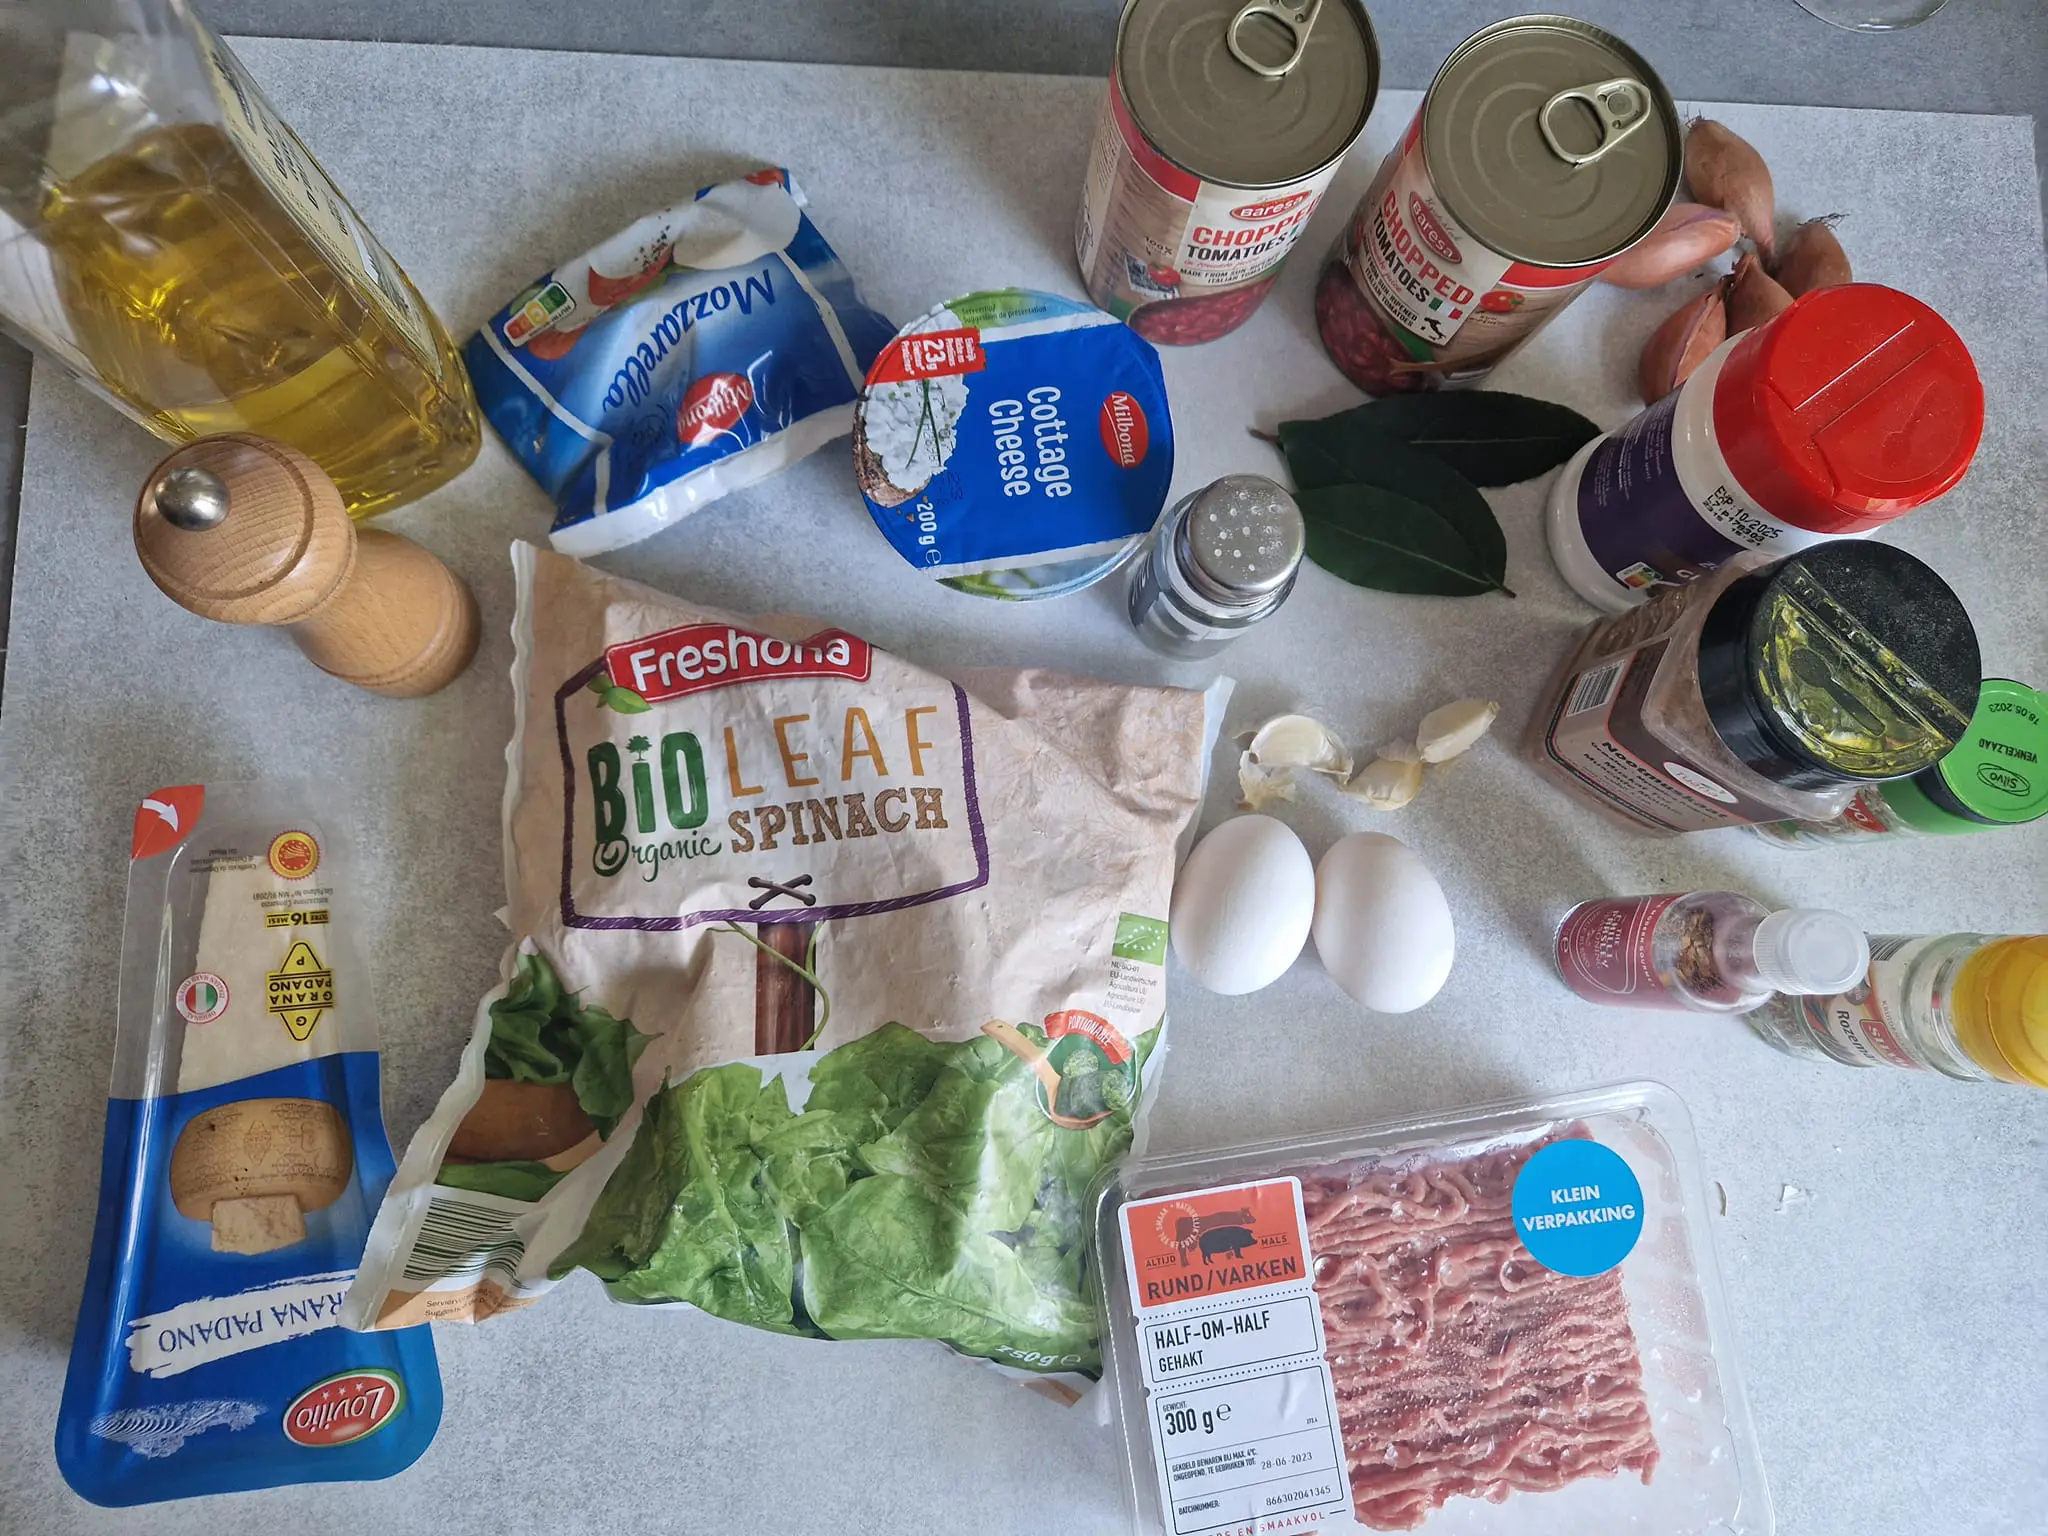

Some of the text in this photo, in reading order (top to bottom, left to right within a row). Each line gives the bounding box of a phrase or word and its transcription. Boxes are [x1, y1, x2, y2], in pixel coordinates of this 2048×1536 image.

[1240, 196, 1304, 217] Baresa
[1412, 200, 1453, 258] Baresa
[1187, 232, 1287, 262] TOMATOES
[1373, 207, 1430, 303] TOMATOES
[1384, 190, 1475, 305] CHOPPED
[1382, 296, 1413, 327] TOMATOES
[603, 269, 777, 414] Mozzarella
[1027, 385, 1073, 498] Cottage
[1110, 393, 1136, 465] Milbona
[989, 399, 1031, 497] Cheese
[916, 502, 937, 532] 200
[630, 628, 851, 693] Freshona
[723, 705, 938, 798] LEAF
[1979, 738, 2038, 764] VENKELZAAD
[1990, 772, 2019, 789] Silvo
[727, 787, 949, 853] SPINACH
[592, 829, 723, 882] Organic
[268, 917, 289, 925] MESI
[291, 912, 309, 926] 16
[296, 956, 305, 966] P
[269, 977, 332, 992] PADANO
[269, 991, 333, 1005] GRANA
[296, 1015, 307, 1027] G
[1550, 1183, 1601, 1206] KLEIN
[1522, 1203, 1637, 1232] VERPAKKING
[1261, 1235, 1288, 1247] MALS
[1146, 1255, 1176, 1268] ALTIJD
[158, 1293, 344, 1353] RANA PADANO
[1155, 1310, 1270, 1350] HALF-OM-HALF
[1159, 1350, 1204, 1373] GEHAKT
[295, 1386, 387, 1433] Lovilio
[1165, 1408, 1197, 1436] 300
[1202, 1410, 1215, 1434] g
[1172, 1460, 1196, 1472] GEKOELD
[1197, 1456, 1223, 1467] BEWAREN
[1223, 1453, 1232, 1461] BIJ
[1207, 1467, 1214, 1475] TE
[1215, 1461, 1245, 1473] GEBRUIKEN
[1265, 1485, 1331, 1506] 866302041345
[1259, 1512, 1325, 1533] SMAAKVOL
